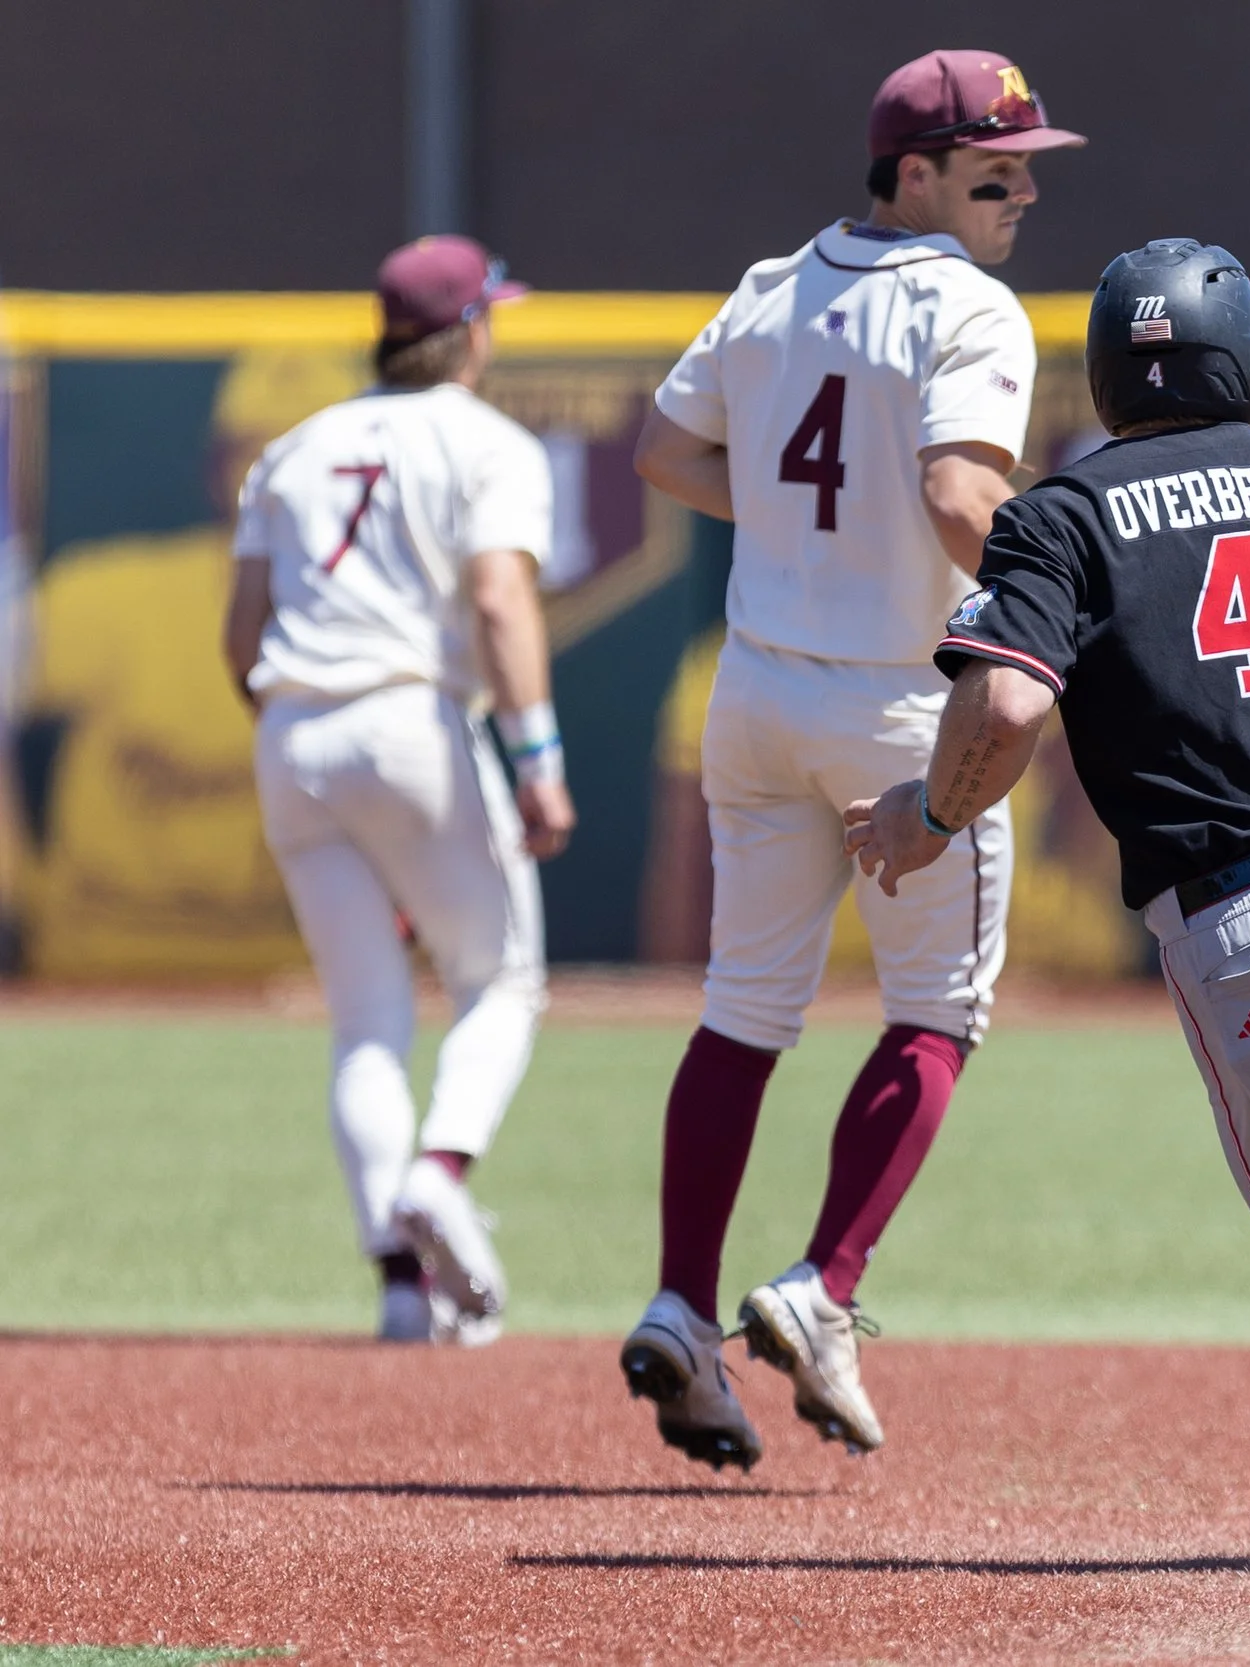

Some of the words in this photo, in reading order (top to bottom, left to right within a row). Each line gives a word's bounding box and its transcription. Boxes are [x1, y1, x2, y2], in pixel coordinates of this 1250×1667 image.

[1146, 361, 1164, 388] 4
[777, 373, 847, 533] 4
[320, 463, 387, 577] 7
